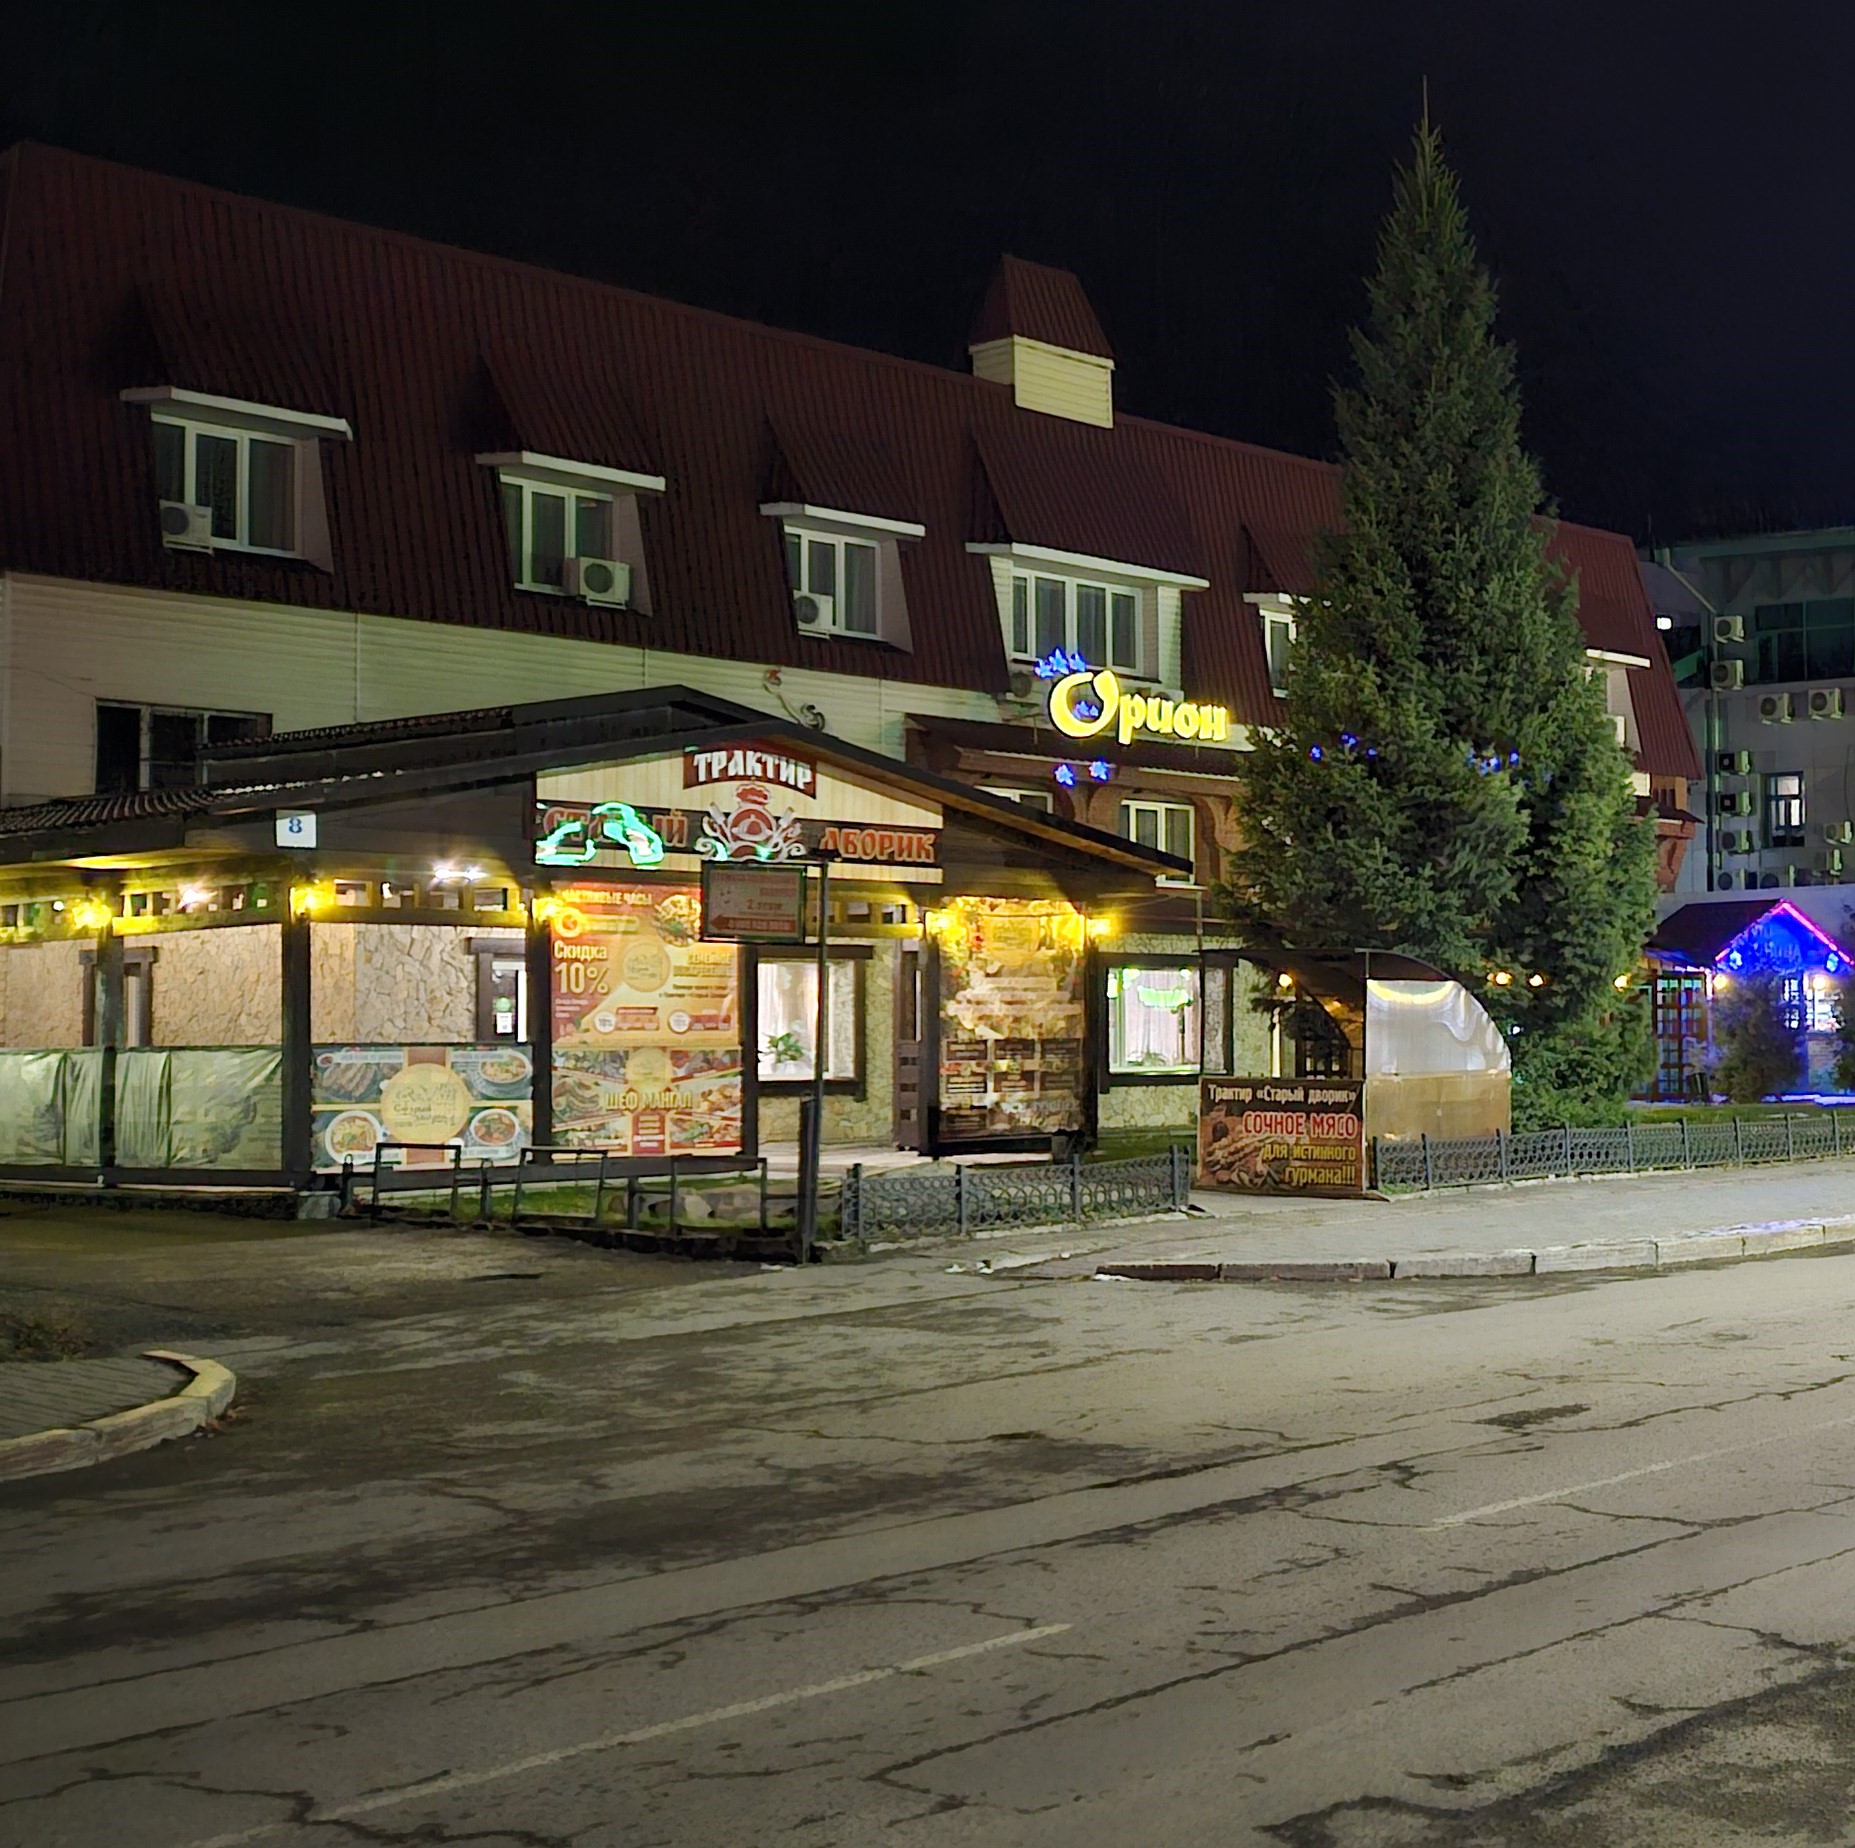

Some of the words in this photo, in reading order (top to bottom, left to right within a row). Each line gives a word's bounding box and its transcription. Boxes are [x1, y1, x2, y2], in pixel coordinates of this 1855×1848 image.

[1050, 670, 1227, 745] Орион
[693, 750, 813, 790] ТРАКТИР
[289, 816, 303, 834] 8
[543, 806, 688, 848] СТЫЙ
[554, 941, 608, 962] Скидка
[554, 962, 609, 995] 10%
[1208, 1085, 1253, 1103] Трактир
[1256, 1085, 1305, 1103] «Старый
[1308, 1087, 1357, 1106] дворик»
[1244, 1112, 1307, 1136] СОЧНОЕ
[1311, 1114, 1358, 1138] МЯСО
[1284, 1165, 1356, 1187] гурмана!!!
